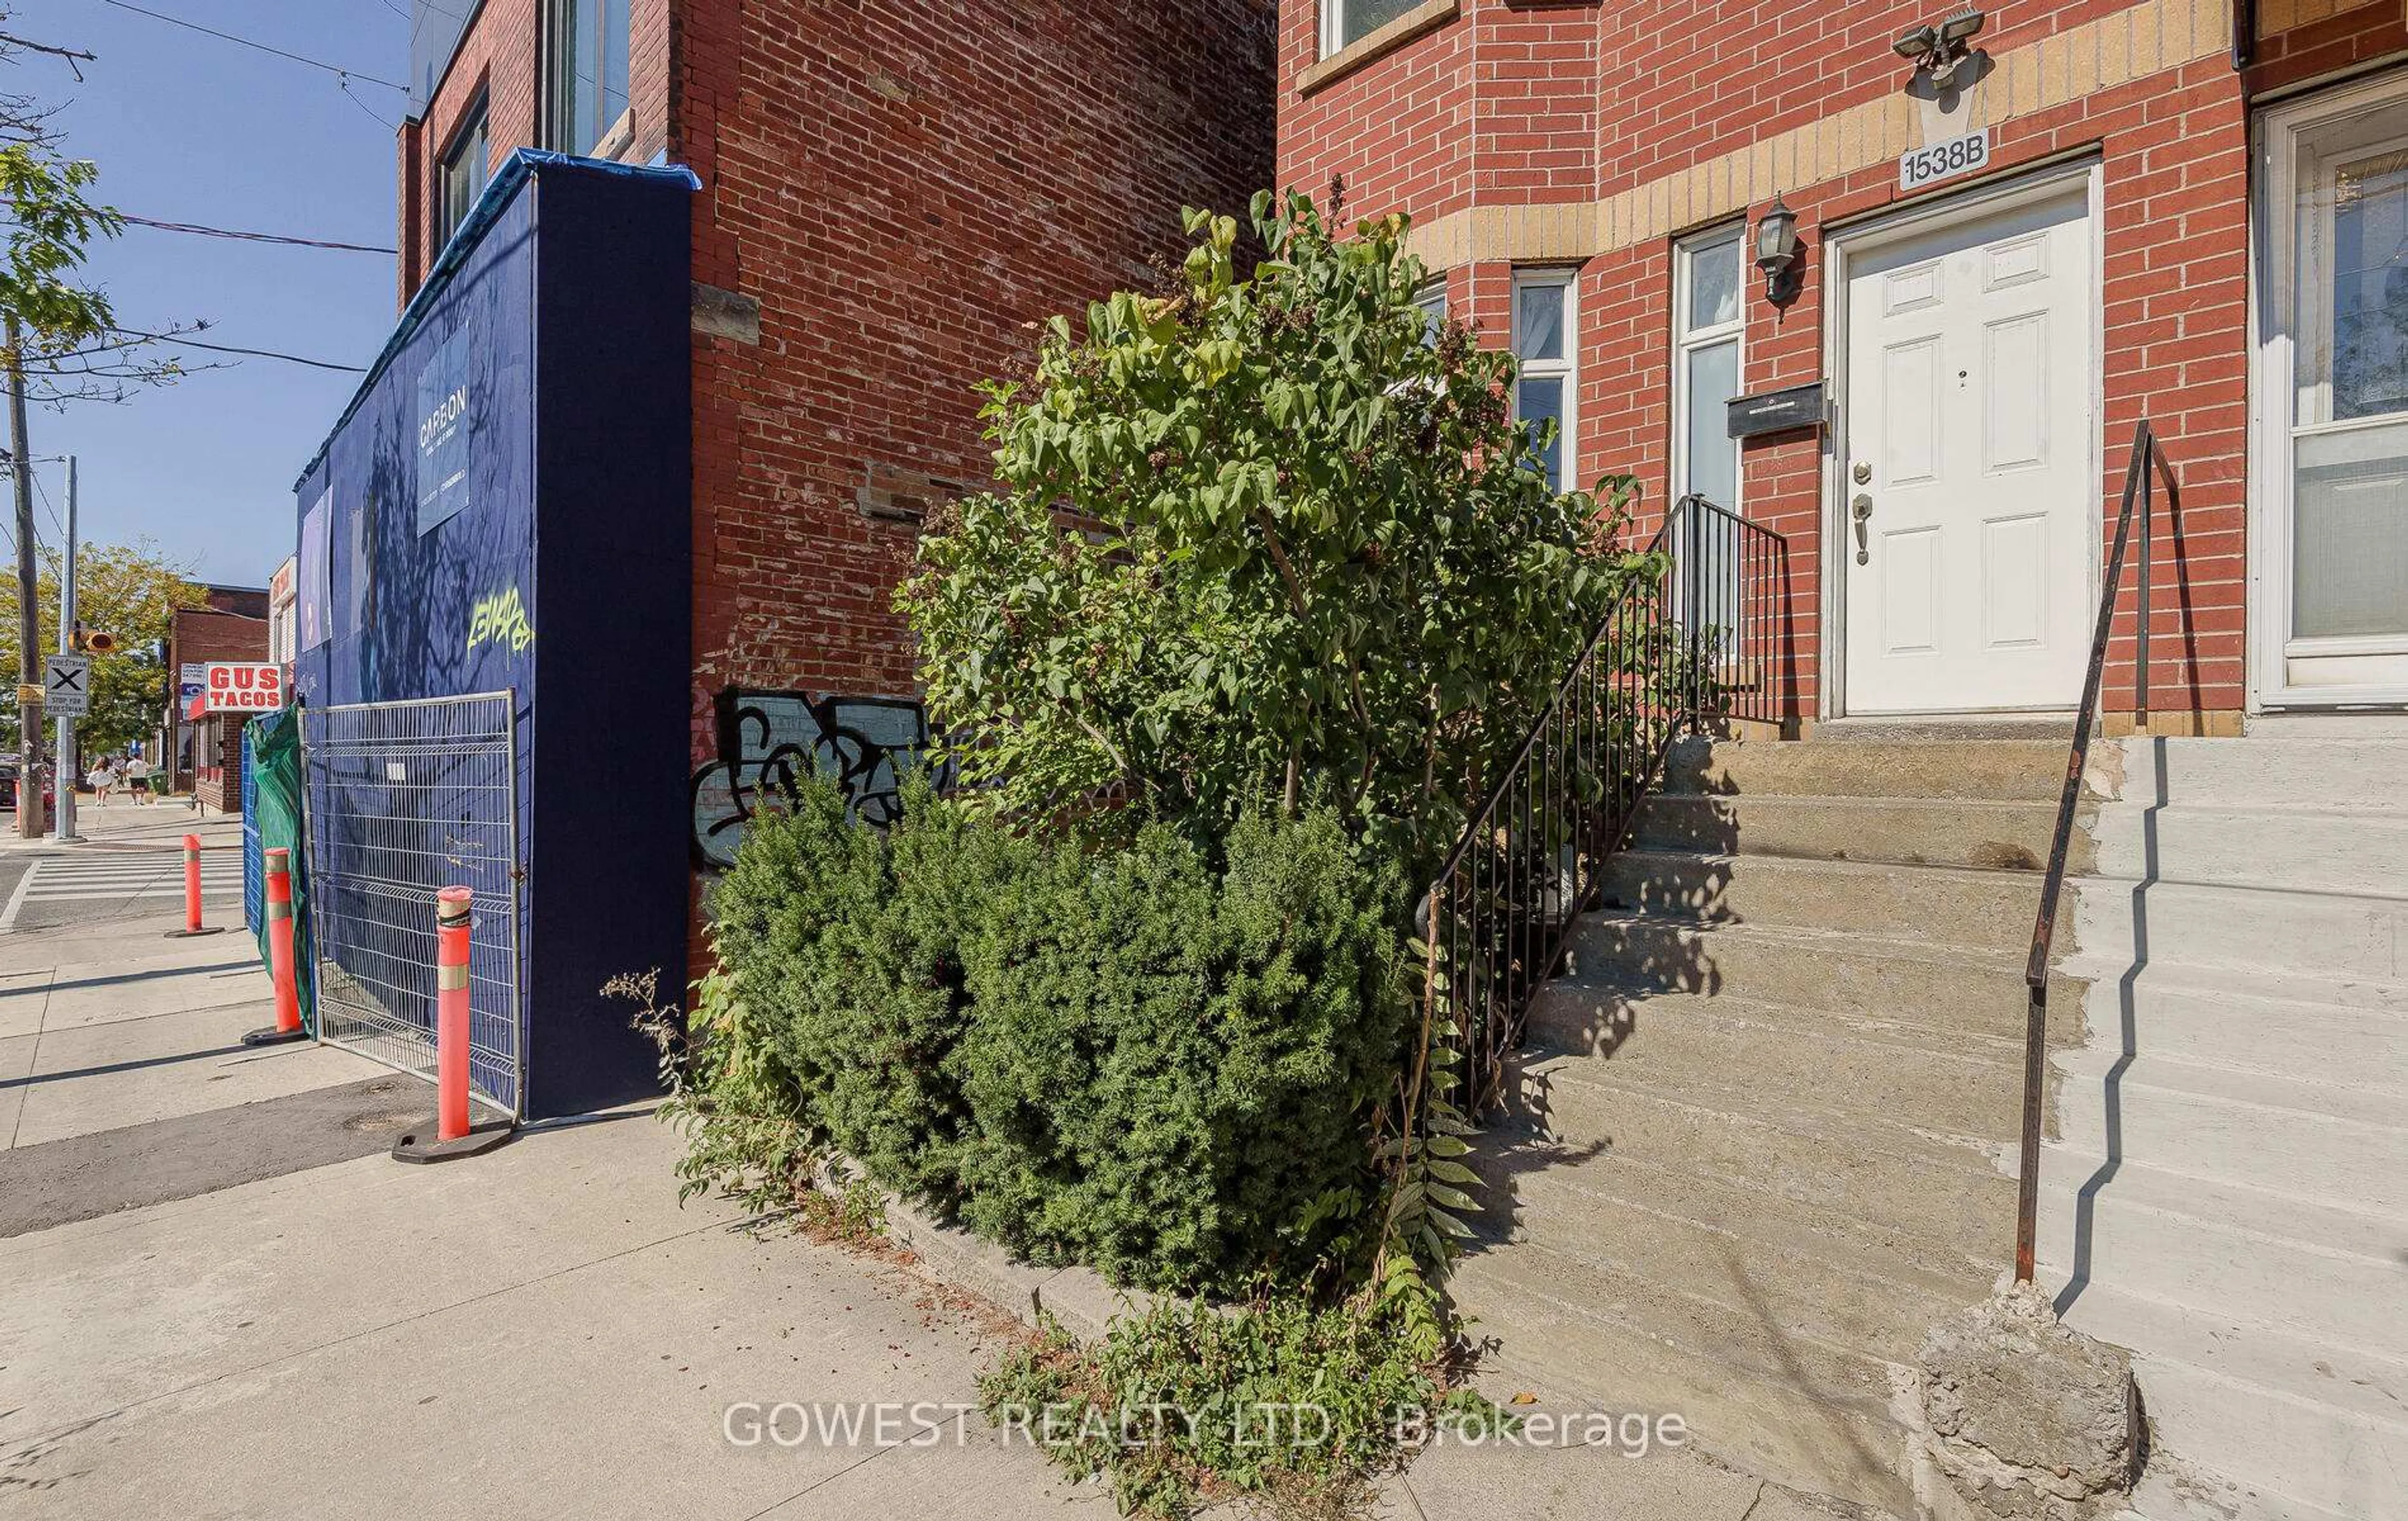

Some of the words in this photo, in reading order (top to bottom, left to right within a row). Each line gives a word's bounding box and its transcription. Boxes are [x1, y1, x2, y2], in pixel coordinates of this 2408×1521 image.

[1905, 135, 1984, 183] 1538B
[421, 385, 465, 448] CARBON
[48, 659, 87, 667] PEDESTRIAN
[210, 667, 280, 690] GUS
[210, 692, 280, 707] TACOS
